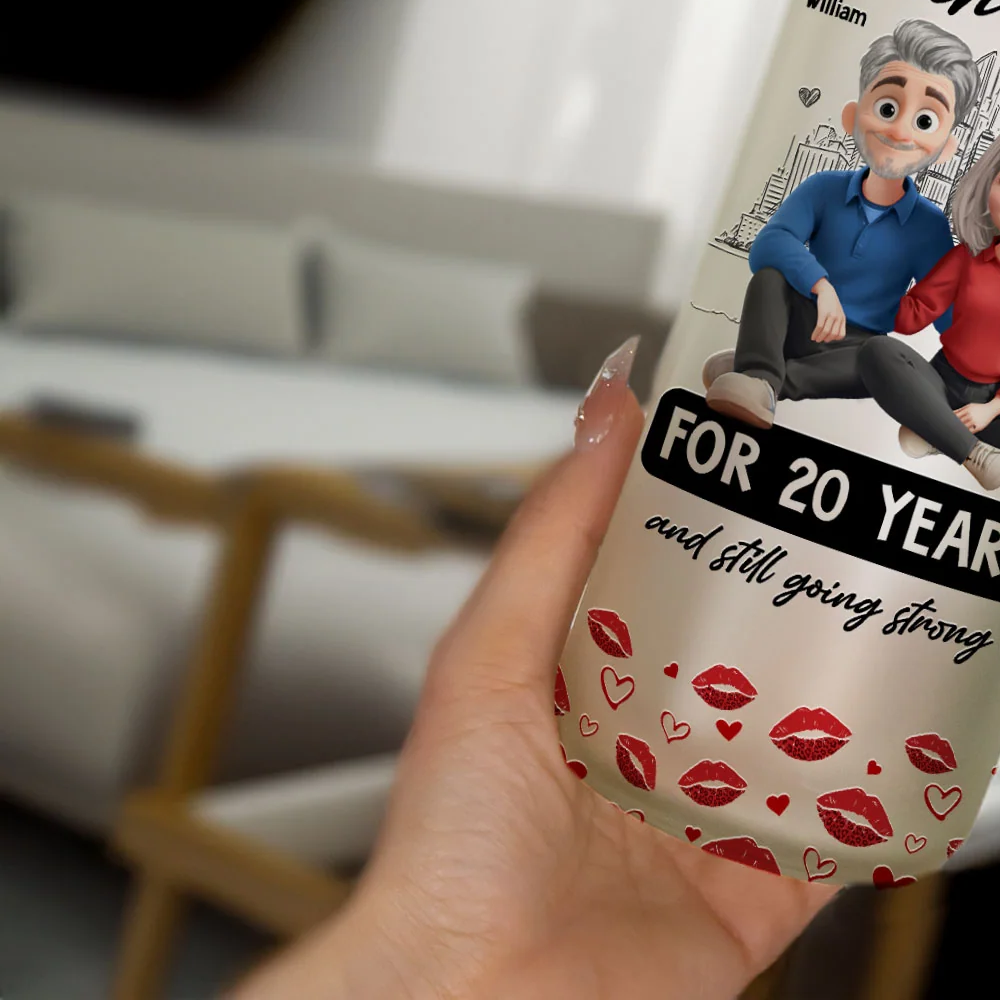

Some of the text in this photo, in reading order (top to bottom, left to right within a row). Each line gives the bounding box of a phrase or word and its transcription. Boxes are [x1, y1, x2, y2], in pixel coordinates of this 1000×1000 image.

[659, 406, 761, 492] FOR
[778, 457, 850, 522] 20
[644, 514, 994, 665] and still going strong
